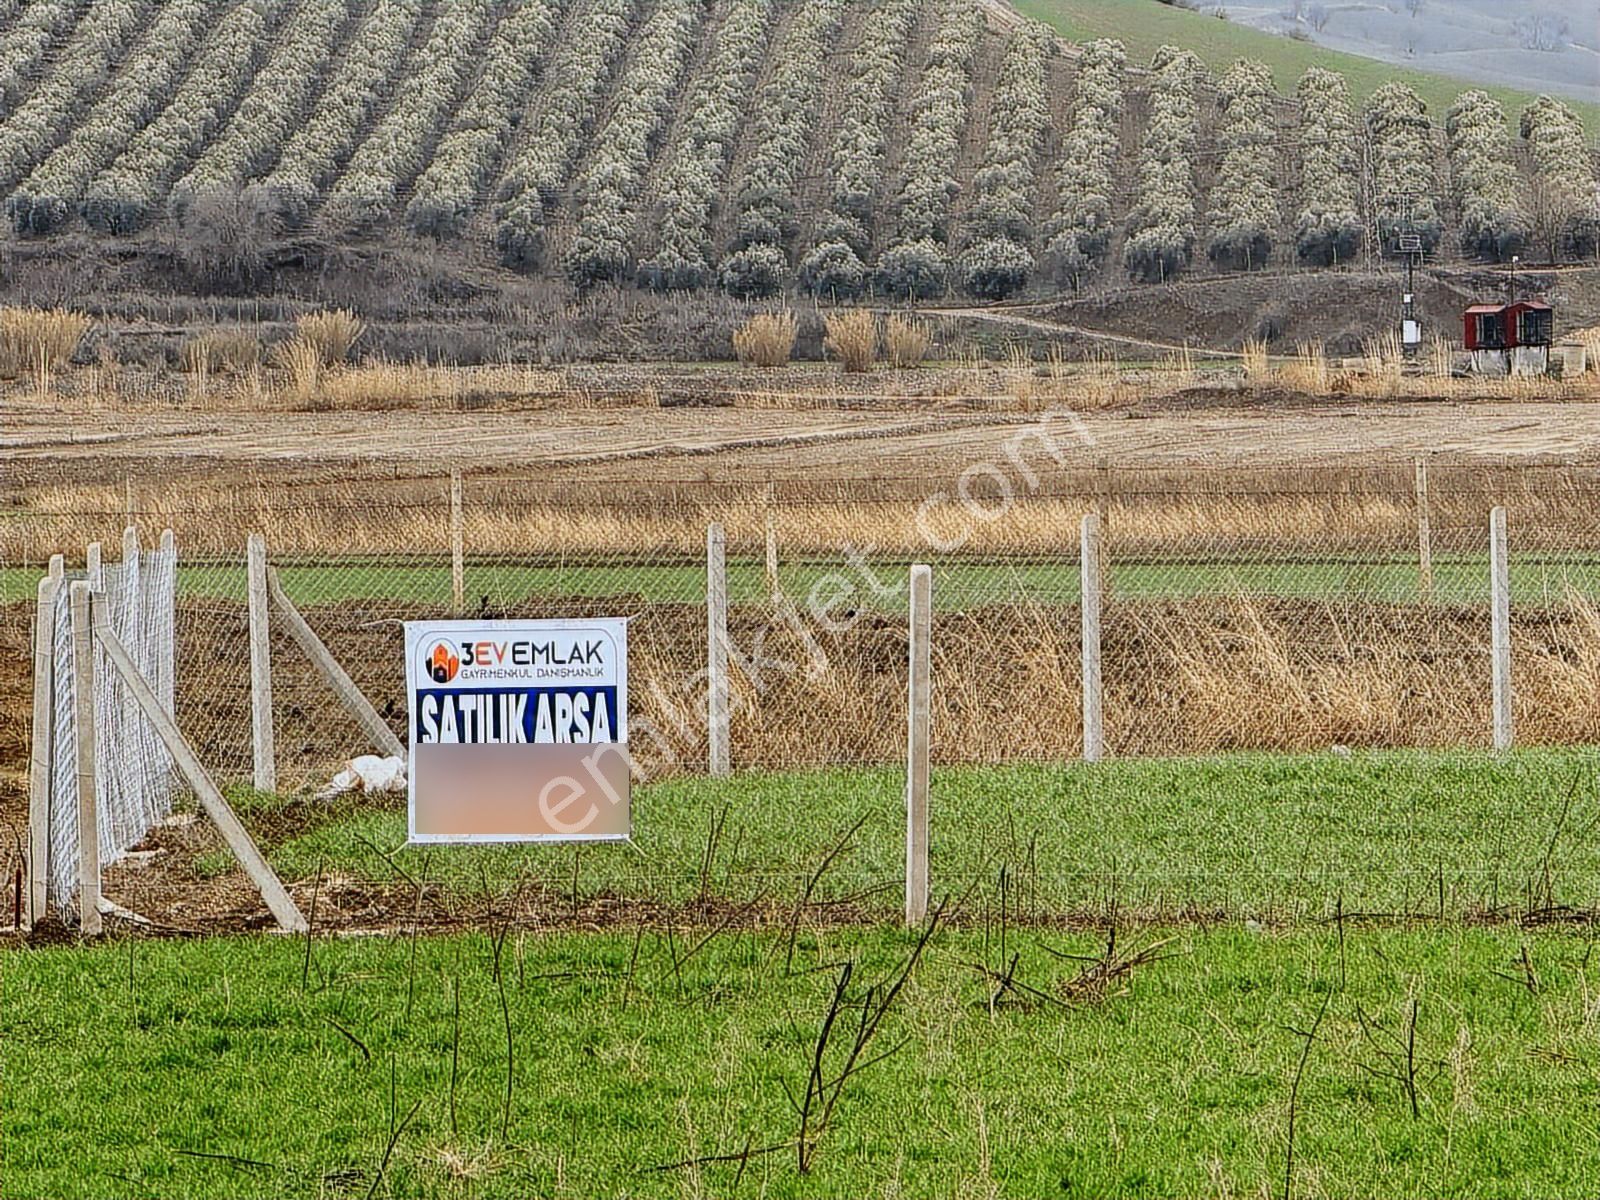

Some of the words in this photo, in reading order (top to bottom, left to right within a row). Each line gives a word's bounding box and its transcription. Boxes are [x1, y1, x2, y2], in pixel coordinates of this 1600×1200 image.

[461, 640, 508, 666] 3EV
[513, 640, 603, 665] EMLAK
[422, 693, 528, 744] SATILIK
[534, 691, 611, 744] ARSA
